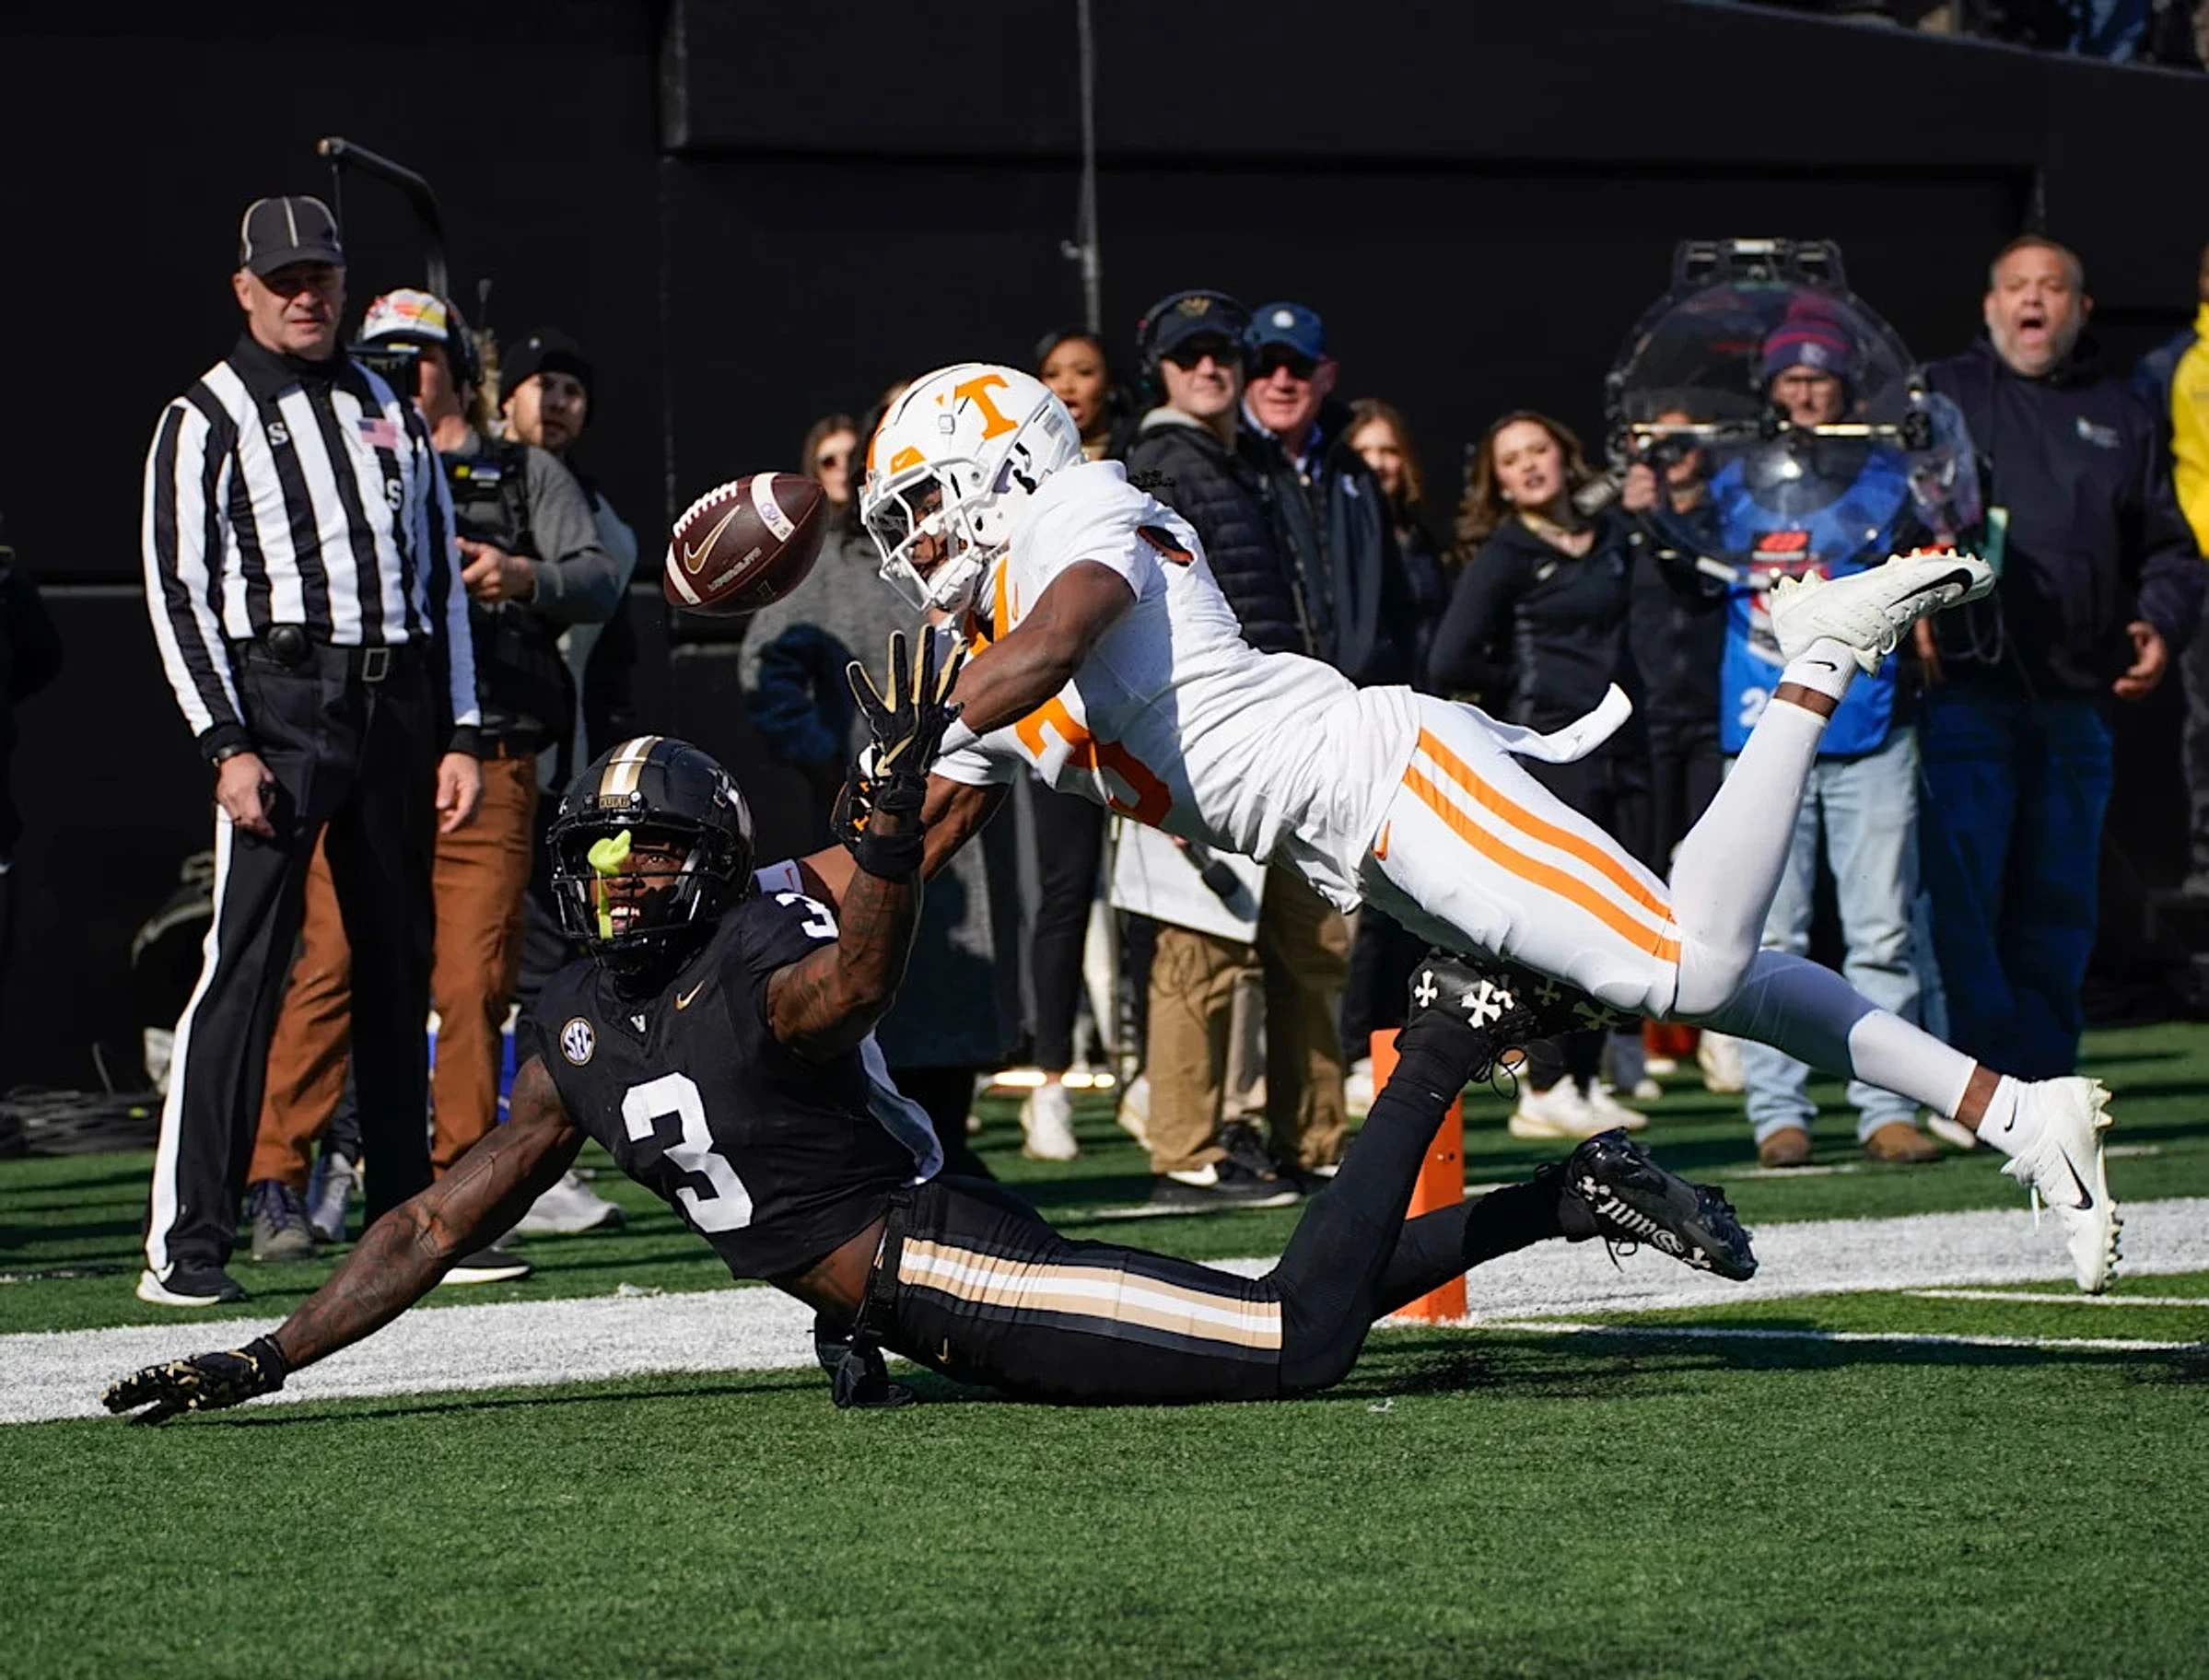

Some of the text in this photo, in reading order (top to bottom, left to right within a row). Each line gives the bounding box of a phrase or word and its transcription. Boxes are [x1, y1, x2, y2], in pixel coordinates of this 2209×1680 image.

[936, 374, 1019, 441] T
[267, 422, 289, 446] S
[387, 478, 403, 510] S
[1738, 686, 1777, 729] 2
[775, 892, 839, 939] 3
[564, 1021, 592, 1061] SEC
[630, 1014, 646, 1033] V
[621, 1072, 754, 1233] 3
[1596, 1196, 1685, 1254] Saint
